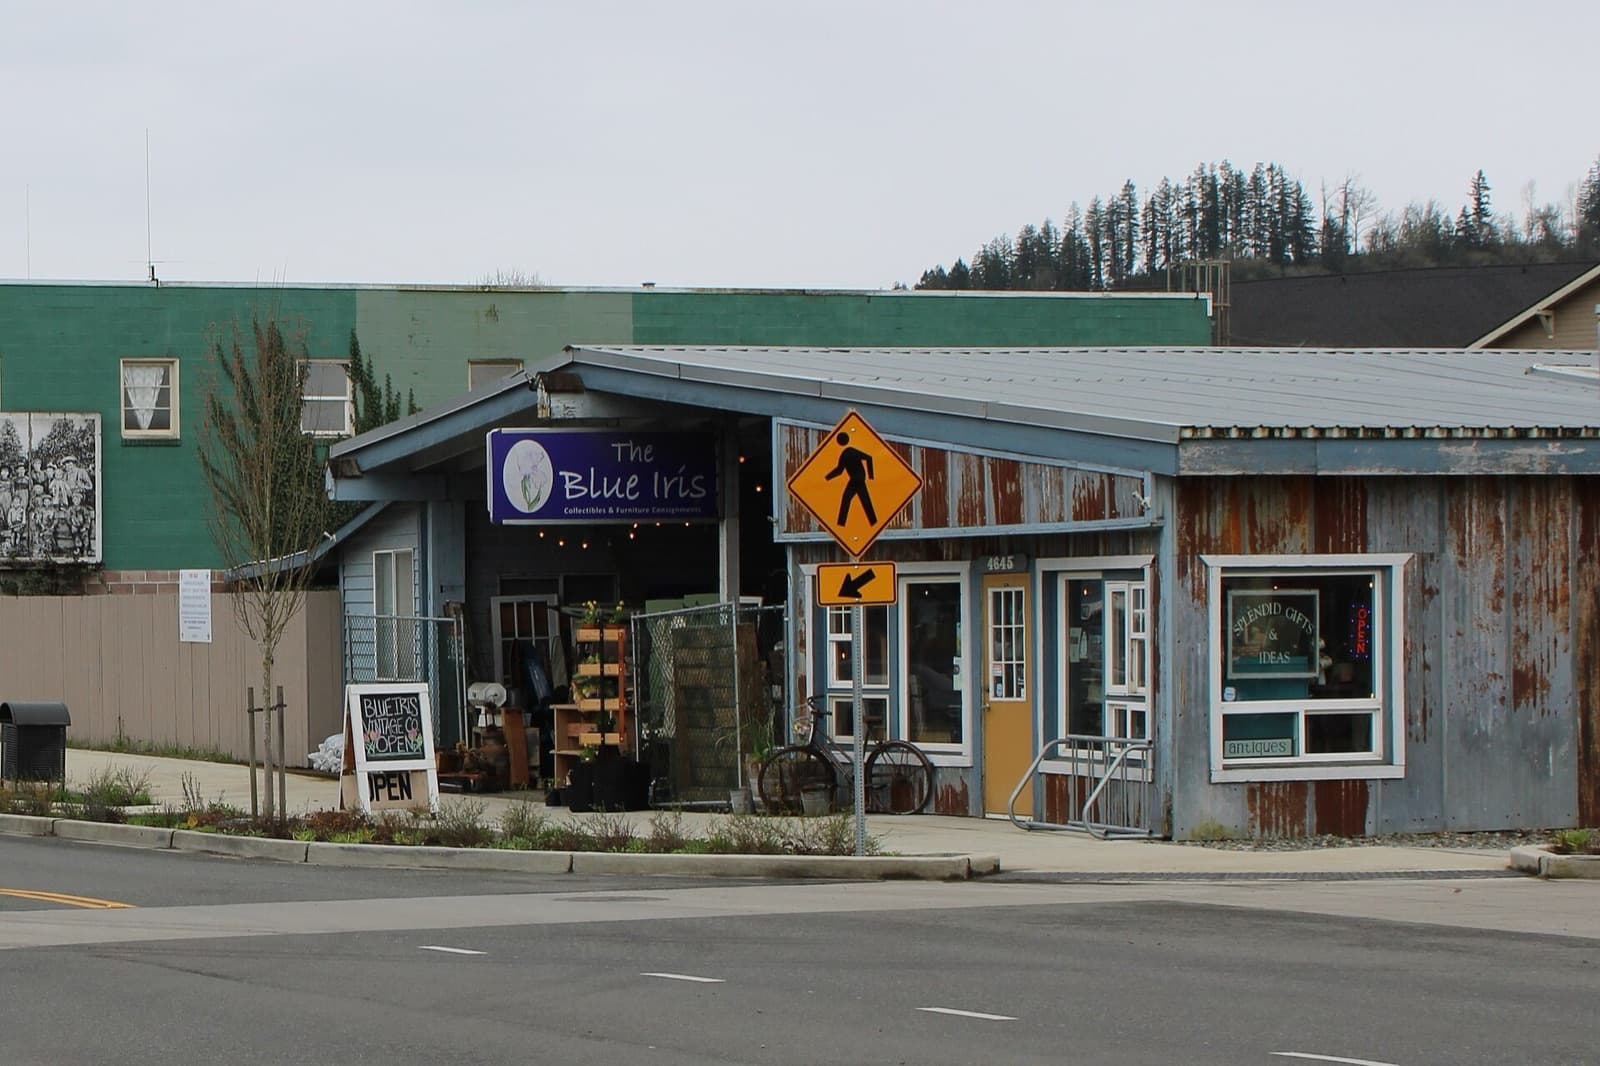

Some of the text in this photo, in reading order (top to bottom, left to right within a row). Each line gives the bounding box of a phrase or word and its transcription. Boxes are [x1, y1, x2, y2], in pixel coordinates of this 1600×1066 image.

[611, 440, 654, 463] The
[559, 464, 707, 500] Blue Iris
[564, 506, 606, 515] Collectibles
[608, 506, 614, 514] &
[616, 506, 650, 514] Furniture
[987, 556, 1014, 570] 4645
[1232, 602, 1314, 637] SPLENDID GIFTS
[1268, 629, 1278, 641] &
[1356, 608, 1368, 654] OPEN
[1259, 651, 1290, 664] IDEAS
[362, 717, 404, 735] VINTAGE
[376, 735, 419, 753] OPEN
[1228, 740, 1287, 755] antiques
